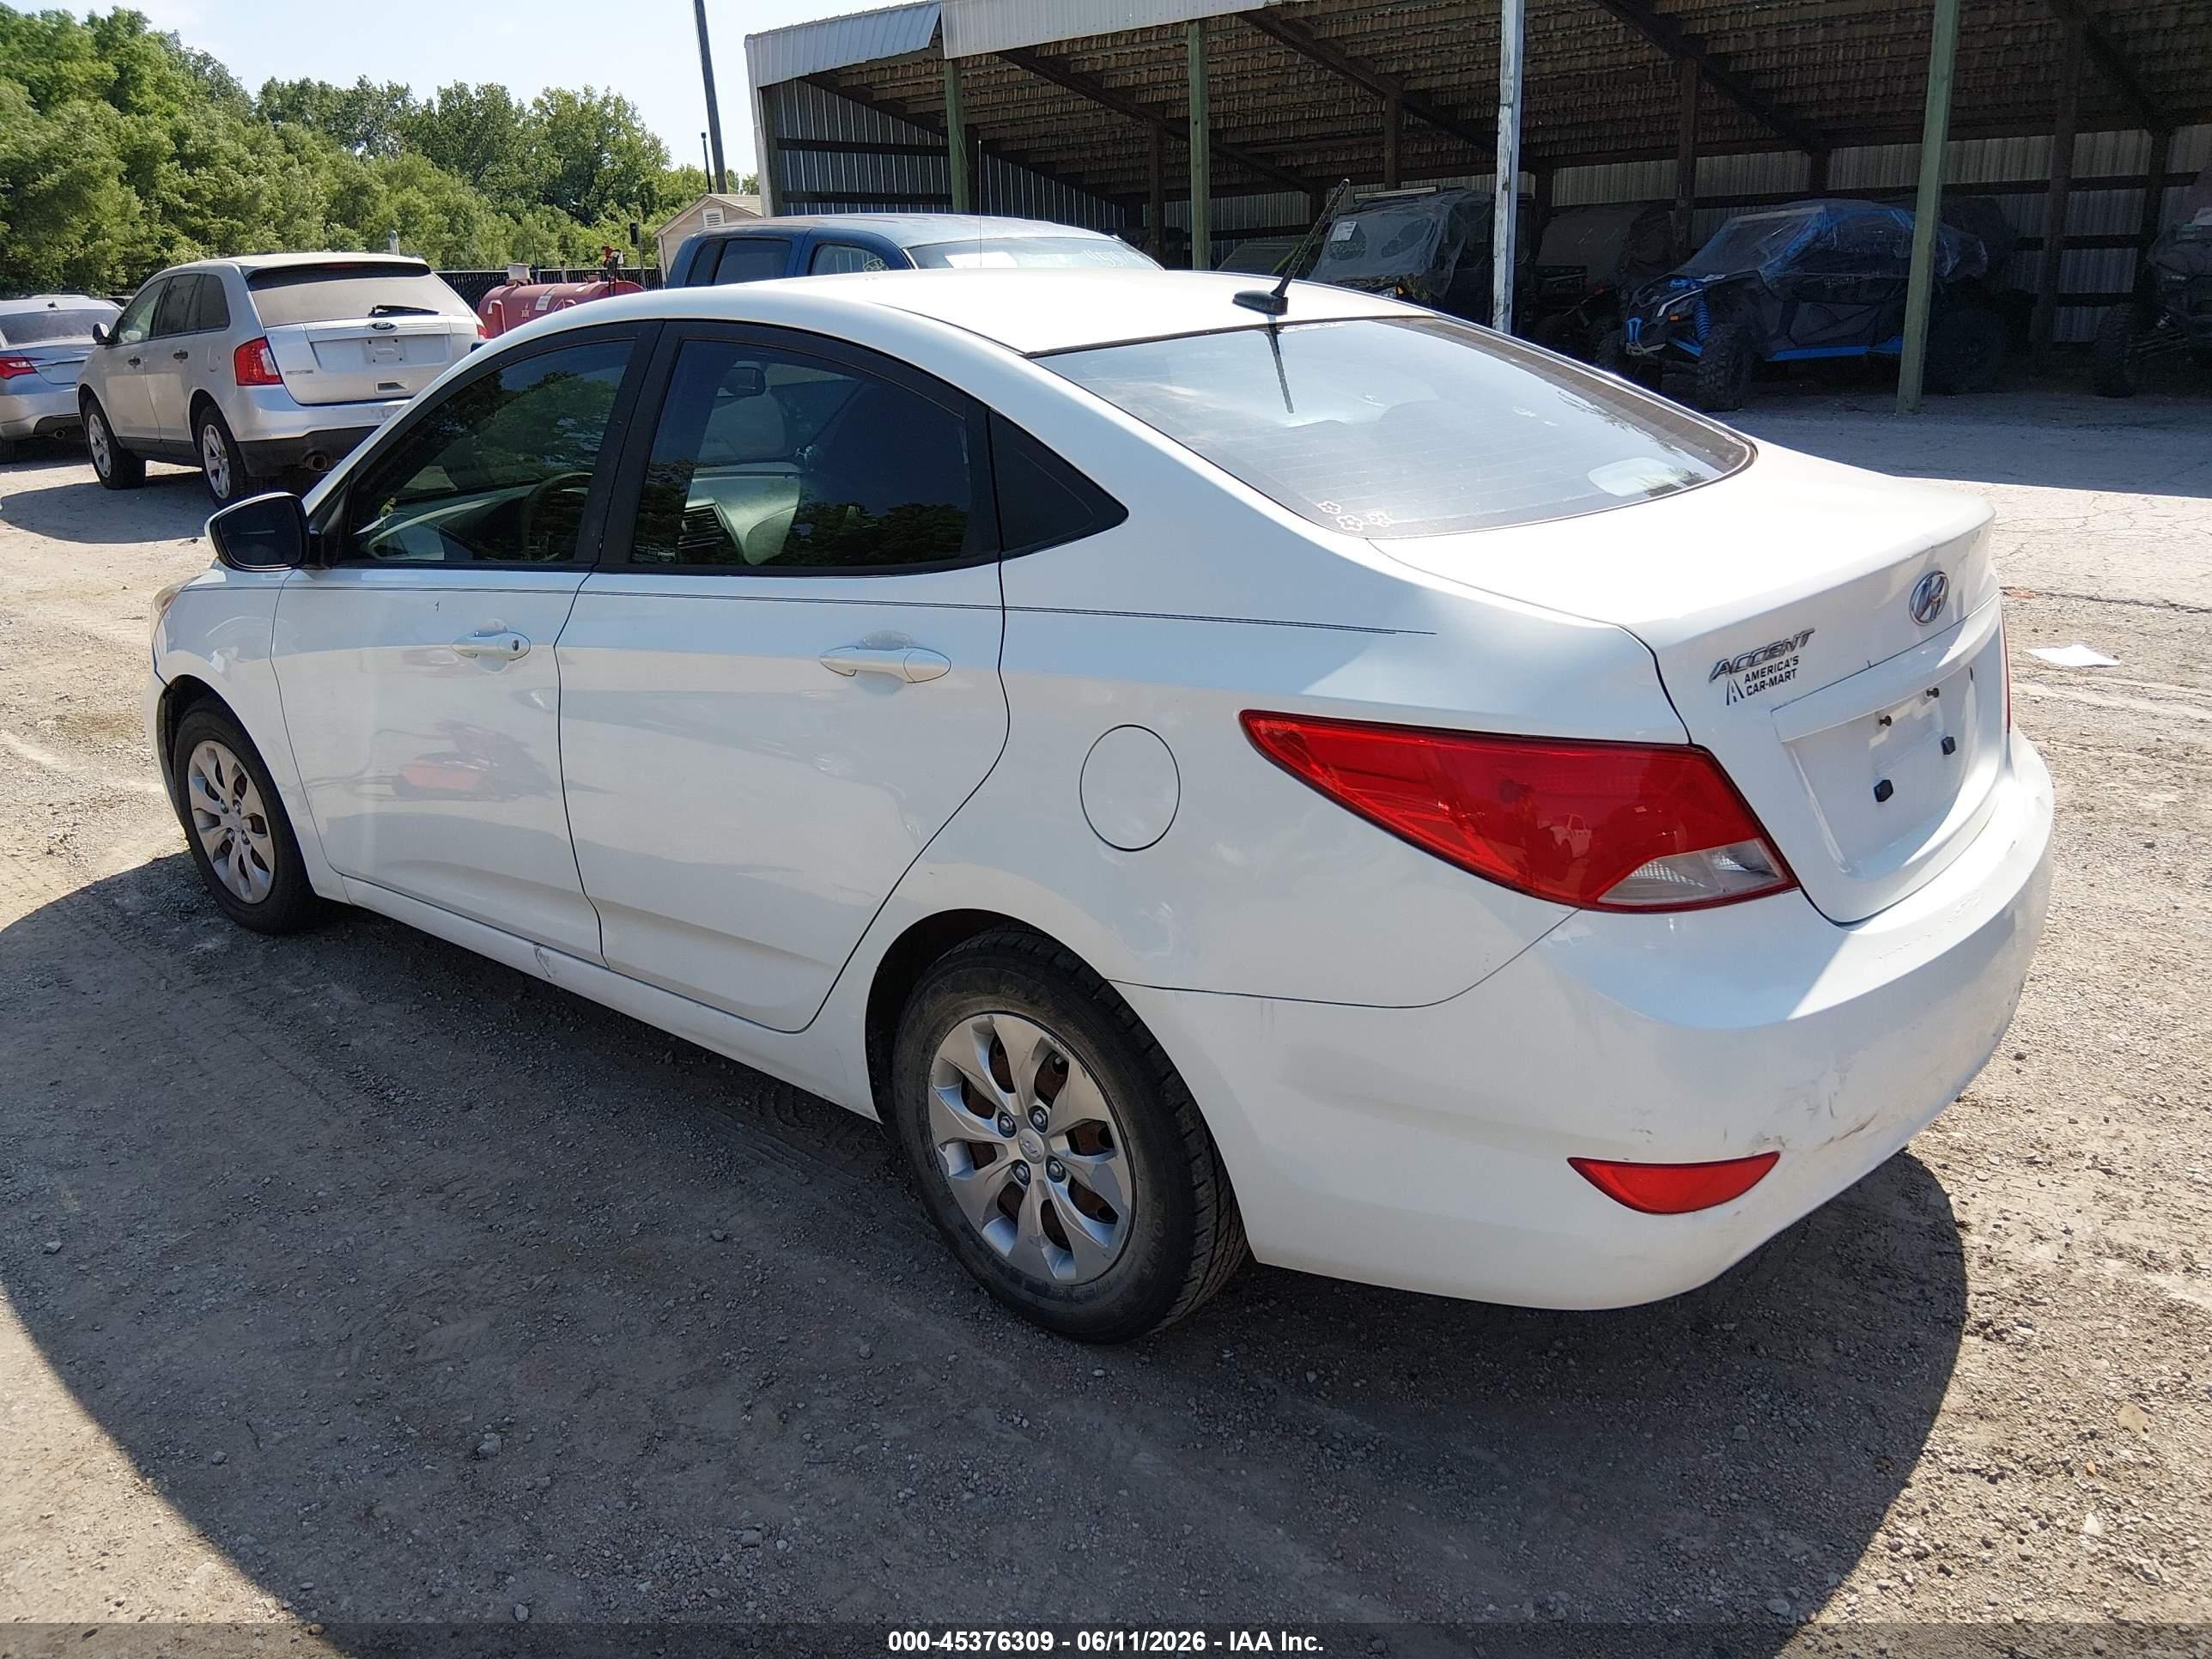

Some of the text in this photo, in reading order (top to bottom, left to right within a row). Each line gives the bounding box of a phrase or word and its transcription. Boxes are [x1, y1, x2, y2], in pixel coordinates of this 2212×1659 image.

[1709, 628, 1815, 683] ACCENT
[1744, 655, 1800, 684] AMERICA'S
[1746, 668, 1797, 696] CAR-MART
